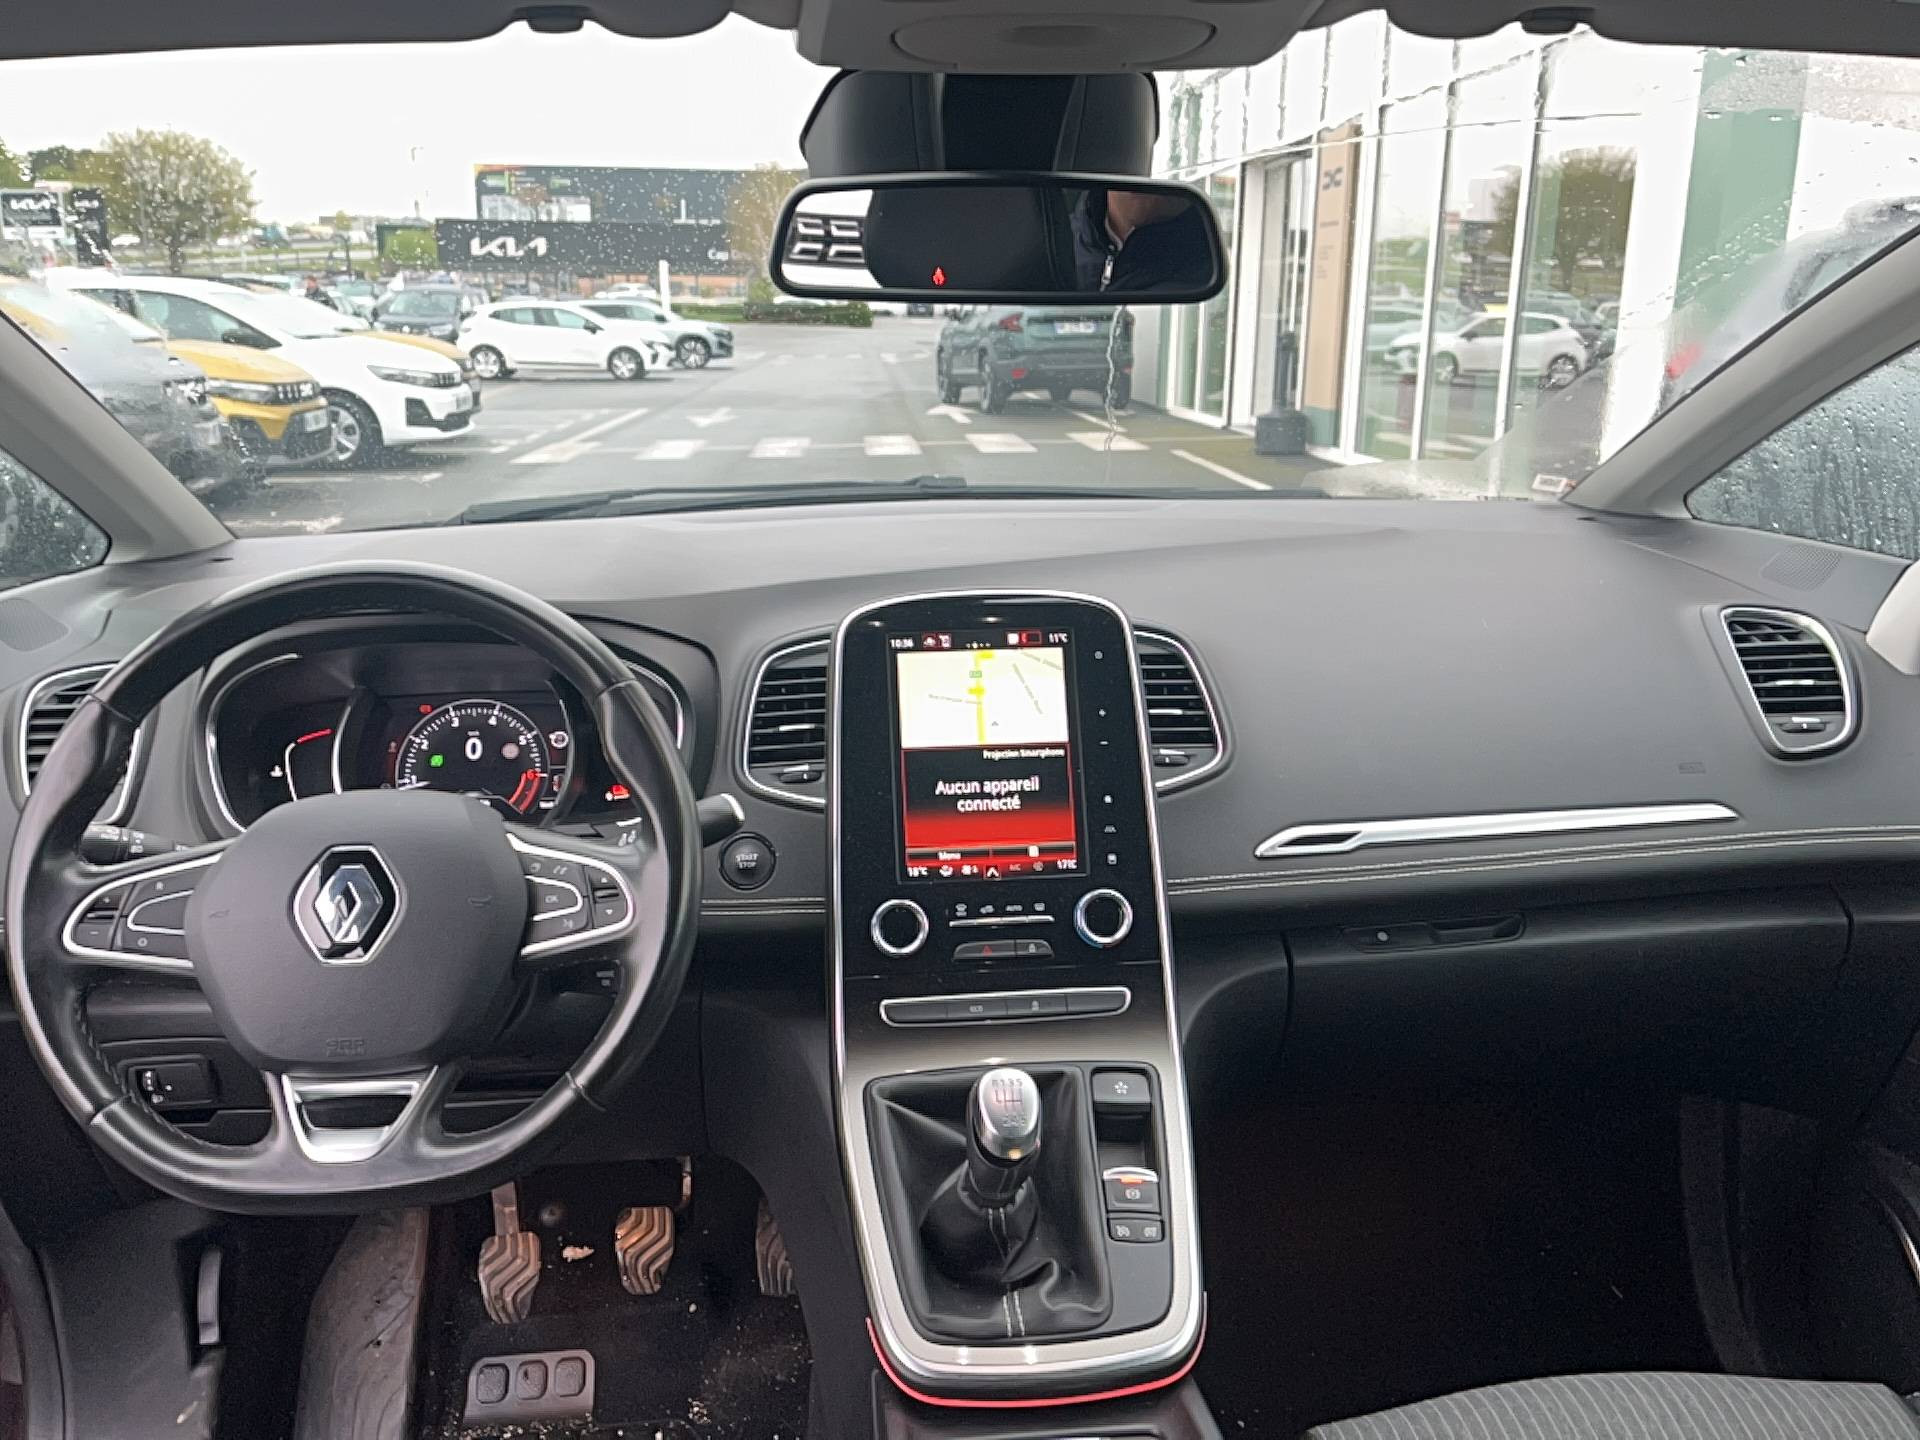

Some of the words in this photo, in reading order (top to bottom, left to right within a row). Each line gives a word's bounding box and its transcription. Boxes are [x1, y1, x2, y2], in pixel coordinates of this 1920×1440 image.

[470, 236, 548, 257] KIA
[451, 717, 460, 728] 3
[464, 736, 483, 761] 0
[518, 735, 527, 746] 5
[935, 780, 982, 796] Aucun
[983, 775, 1040, 796] appareil
[957, 794, 1022, 812] connecté
